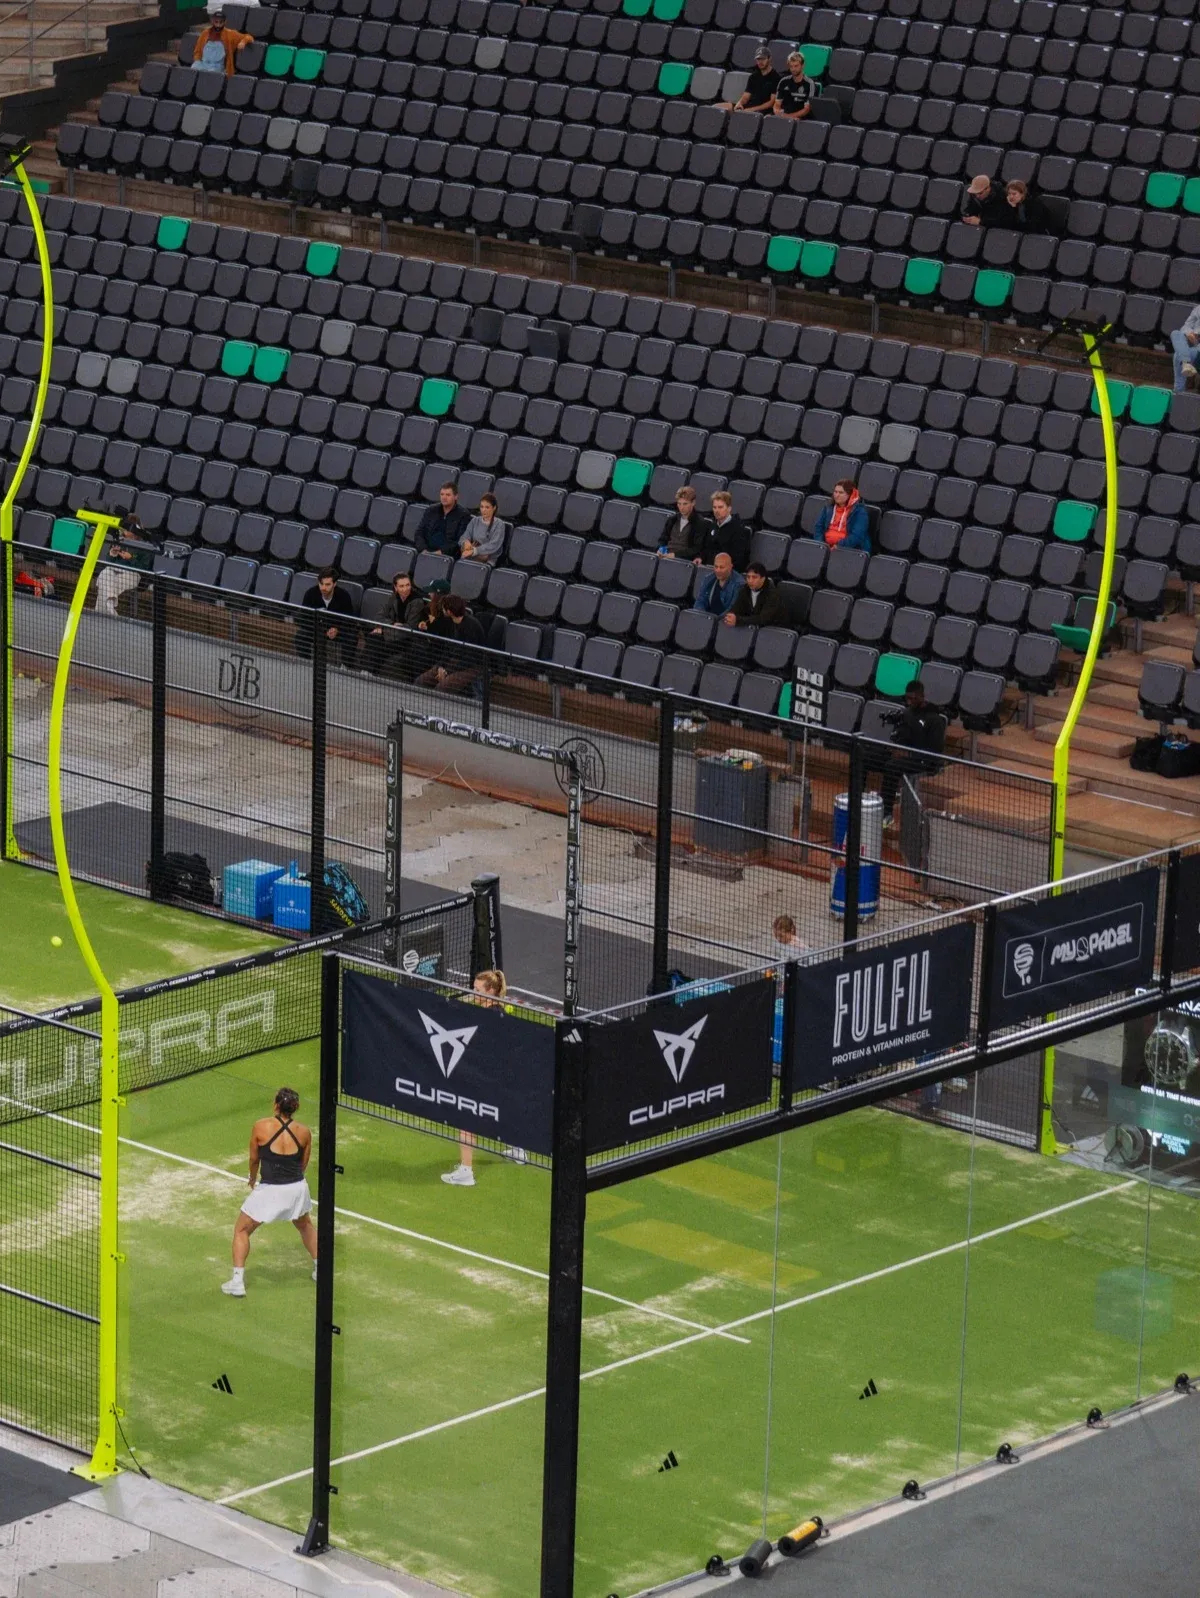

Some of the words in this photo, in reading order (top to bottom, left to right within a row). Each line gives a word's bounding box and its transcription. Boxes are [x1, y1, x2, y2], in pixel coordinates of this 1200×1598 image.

[218, 653, 261, 699] DTB
[278, 906, 306, 915] CERTINA
[274, 946, 298, 957] CERTINA
[419, 952, 442, 962] CERTINA
[144, 982, 168, 993] CERTINA
[833, 950, 932, 1048] FULFIL
[832, 1047, 865, 1066] PROTEIN
[866, 1046, 872, 1055] &
[873, 1036, 904, 1054] VITAMIN
[905, 1028, 931, 1043] RIEGEL
[395, 1077, 499, 1122] CUPRA
[629, 1083, 725, 1126] CUPRA
